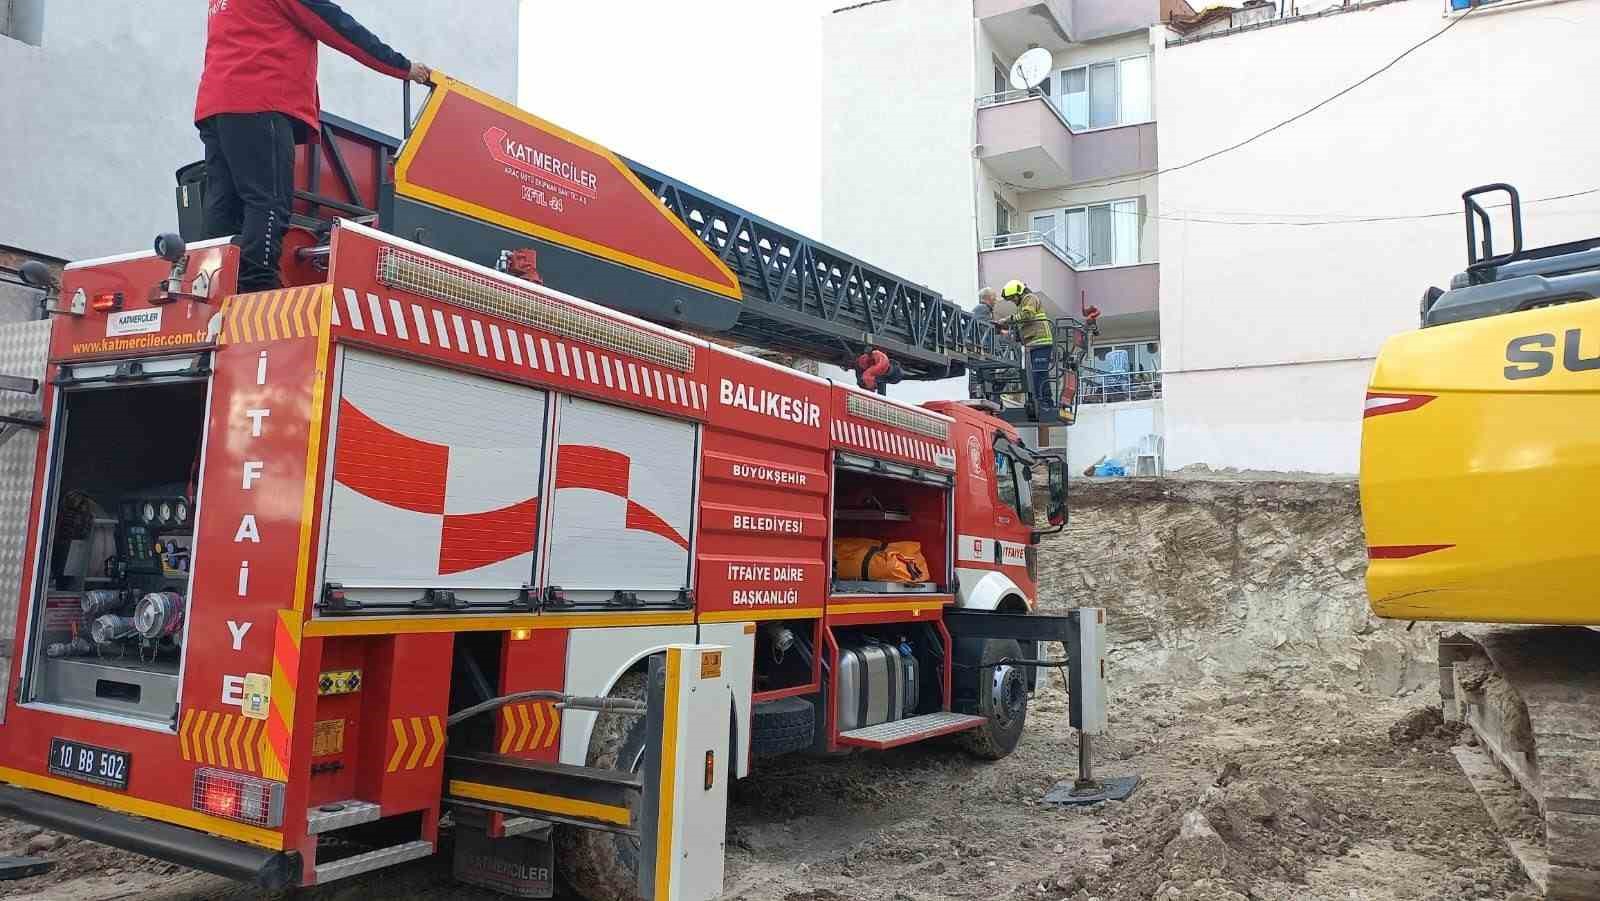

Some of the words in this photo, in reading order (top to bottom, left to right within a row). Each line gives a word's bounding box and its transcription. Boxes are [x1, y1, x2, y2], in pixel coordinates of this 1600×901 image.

[506, 138, 597, 190] KATMERCİLER
[118, 312, 158, 325] KATMERCİLER
[72, 329, 208, 354] www.katmerciler.com.tr
[719, 378, 821, 429] BALIKESİR
[732, 464, 806, 486] BÜYÜKŞEHİR
[221, 350, 271, 706] İTFAİYE
[733, 515, 803, 535] BELEDİYESİ
[727, 562, 771, 582] İTFAİYE
[773, 565, 804, 582] DAİRE
[732, 589, 798, 610] BAŞKANLIĞI
[60, 744, 73, 768] 10
[78, 749, 94, 772] BB
[100, 752, 123, 778] 502
